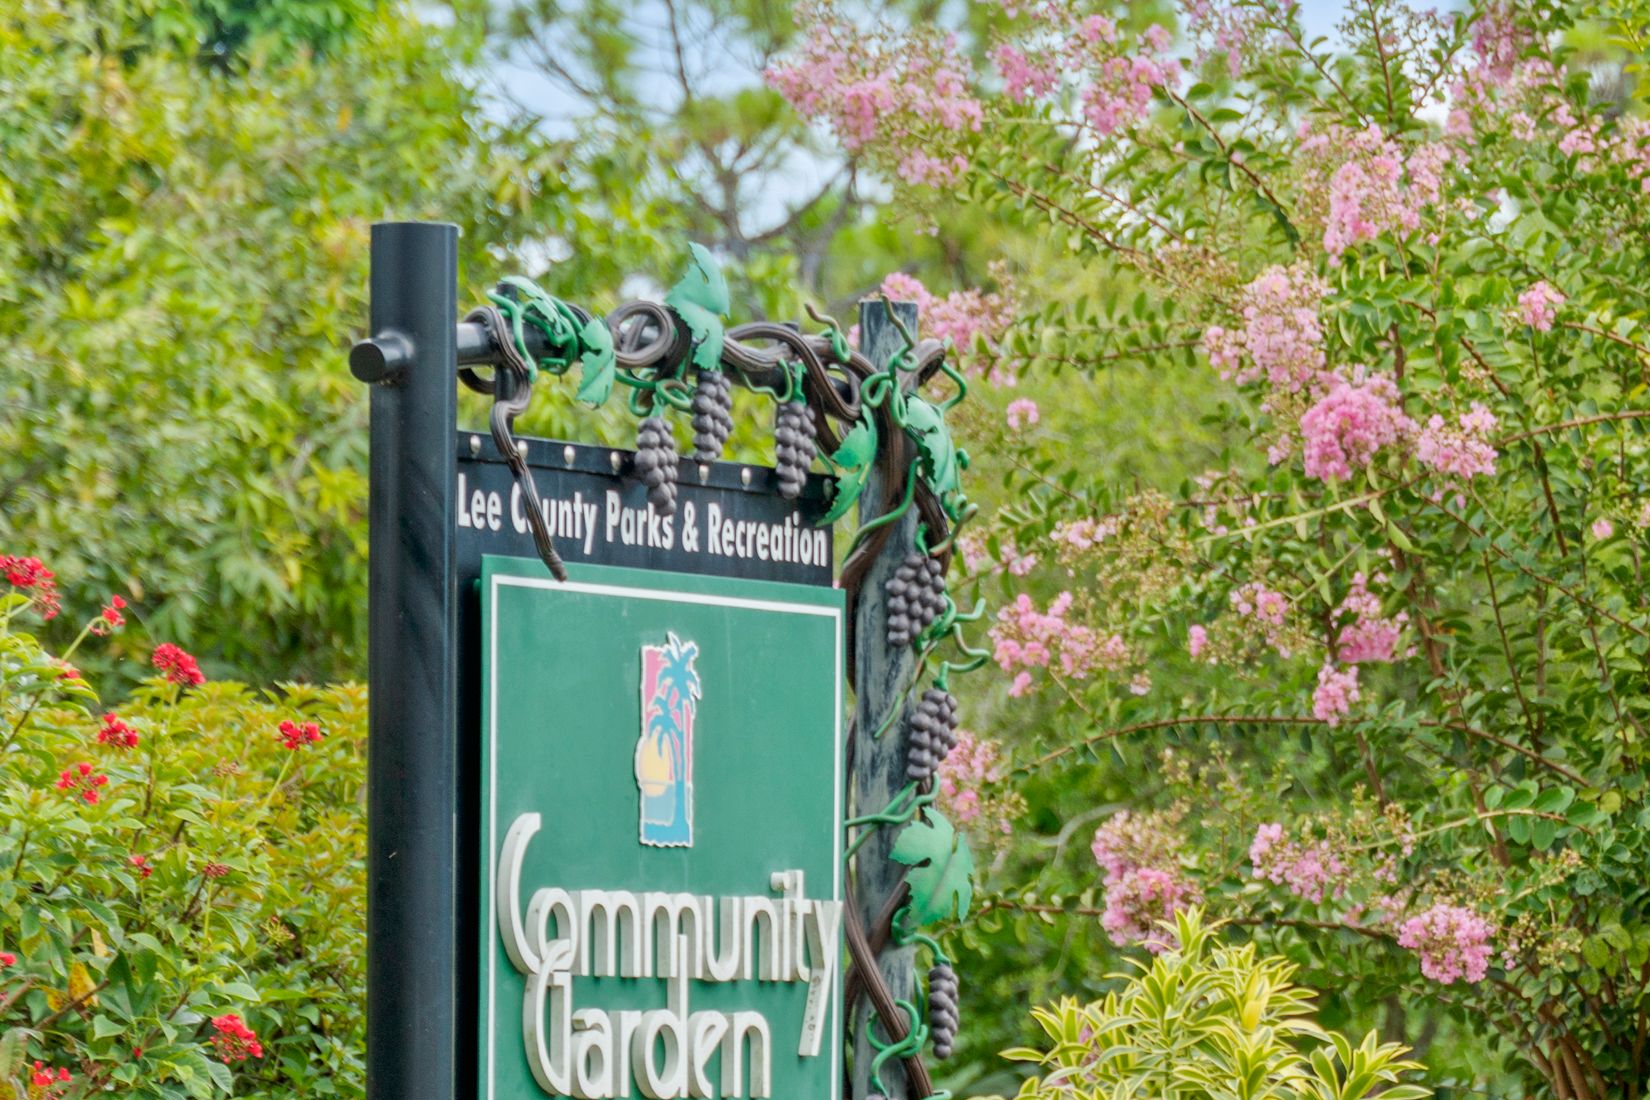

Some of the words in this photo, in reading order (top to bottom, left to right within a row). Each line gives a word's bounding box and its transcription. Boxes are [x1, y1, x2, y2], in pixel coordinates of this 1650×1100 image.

[458, 472, 502, 532] Lee
[511, 481, 597, 555] Cunty
[606, 489, 674, 551] Parks
[682, 500, 699, 553] &
[708, 502, 828, 568] Recreation
[500, 812, 843, 1057] Community
[522, 933, 772, 1100] Garden
